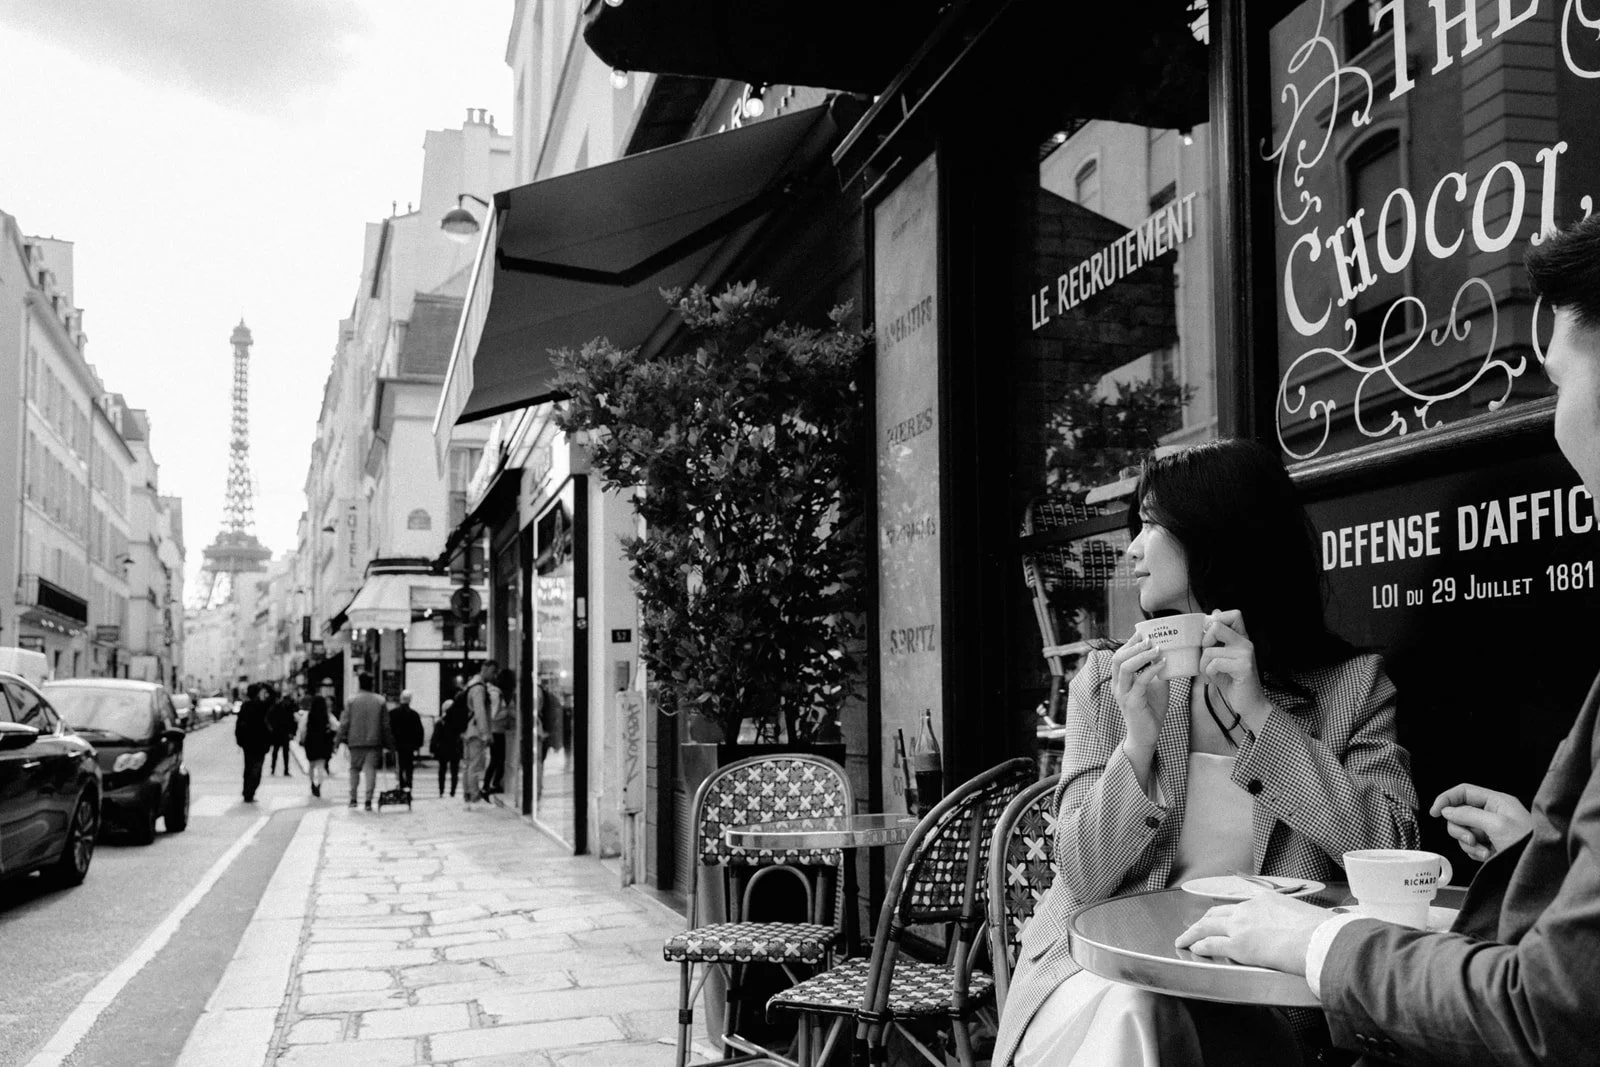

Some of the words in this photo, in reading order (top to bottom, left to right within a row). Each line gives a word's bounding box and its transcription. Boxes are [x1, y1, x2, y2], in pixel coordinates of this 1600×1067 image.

[1031, 285, 1050, 331] LE
[1057, 191, 1196, 315] RECRUTEMENT
[1284, 141, 1592, 336] CHOCOL
[1321, 511, 1441, 571] DEFENSE
[1457, 484, 1600, 551] D'AFFIC
[1372, 583, 1399, 609] LOI
[1406, 589, 1424, 607] DU
[1431, 577, 1456, 604] 29
[1546, 560, 1594, 592] 1881
[890, 624, 936, 655] SPRITZ
